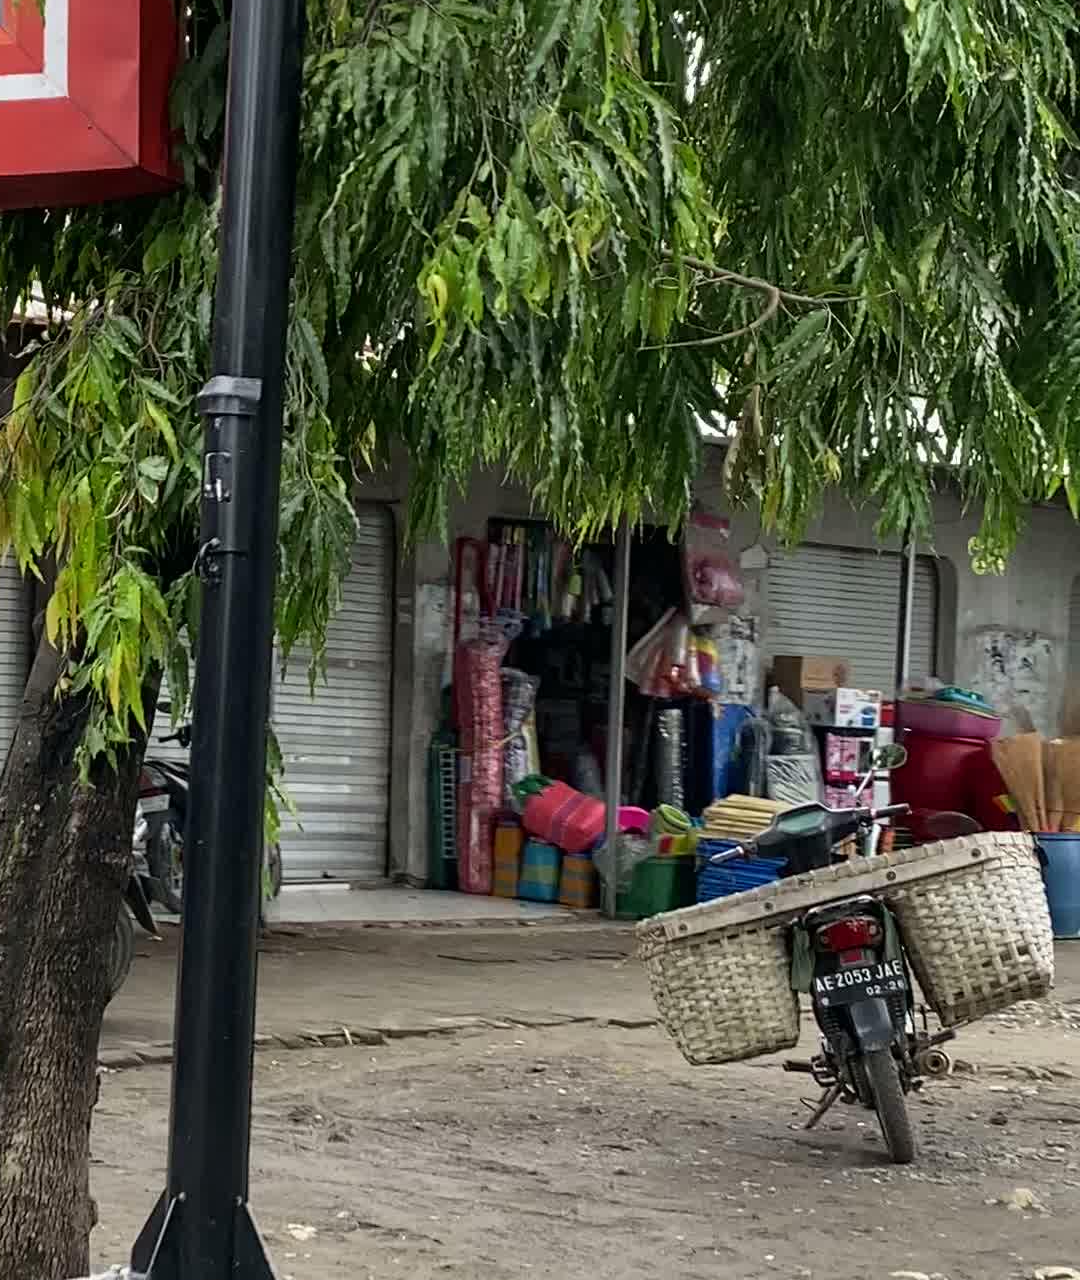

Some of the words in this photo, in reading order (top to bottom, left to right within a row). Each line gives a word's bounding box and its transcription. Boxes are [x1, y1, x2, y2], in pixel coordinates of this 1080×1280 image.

[815, 976, 834, 992] AE
[835, 968, 871, 987] 2053
[875, 960, 901, 979] JAE
